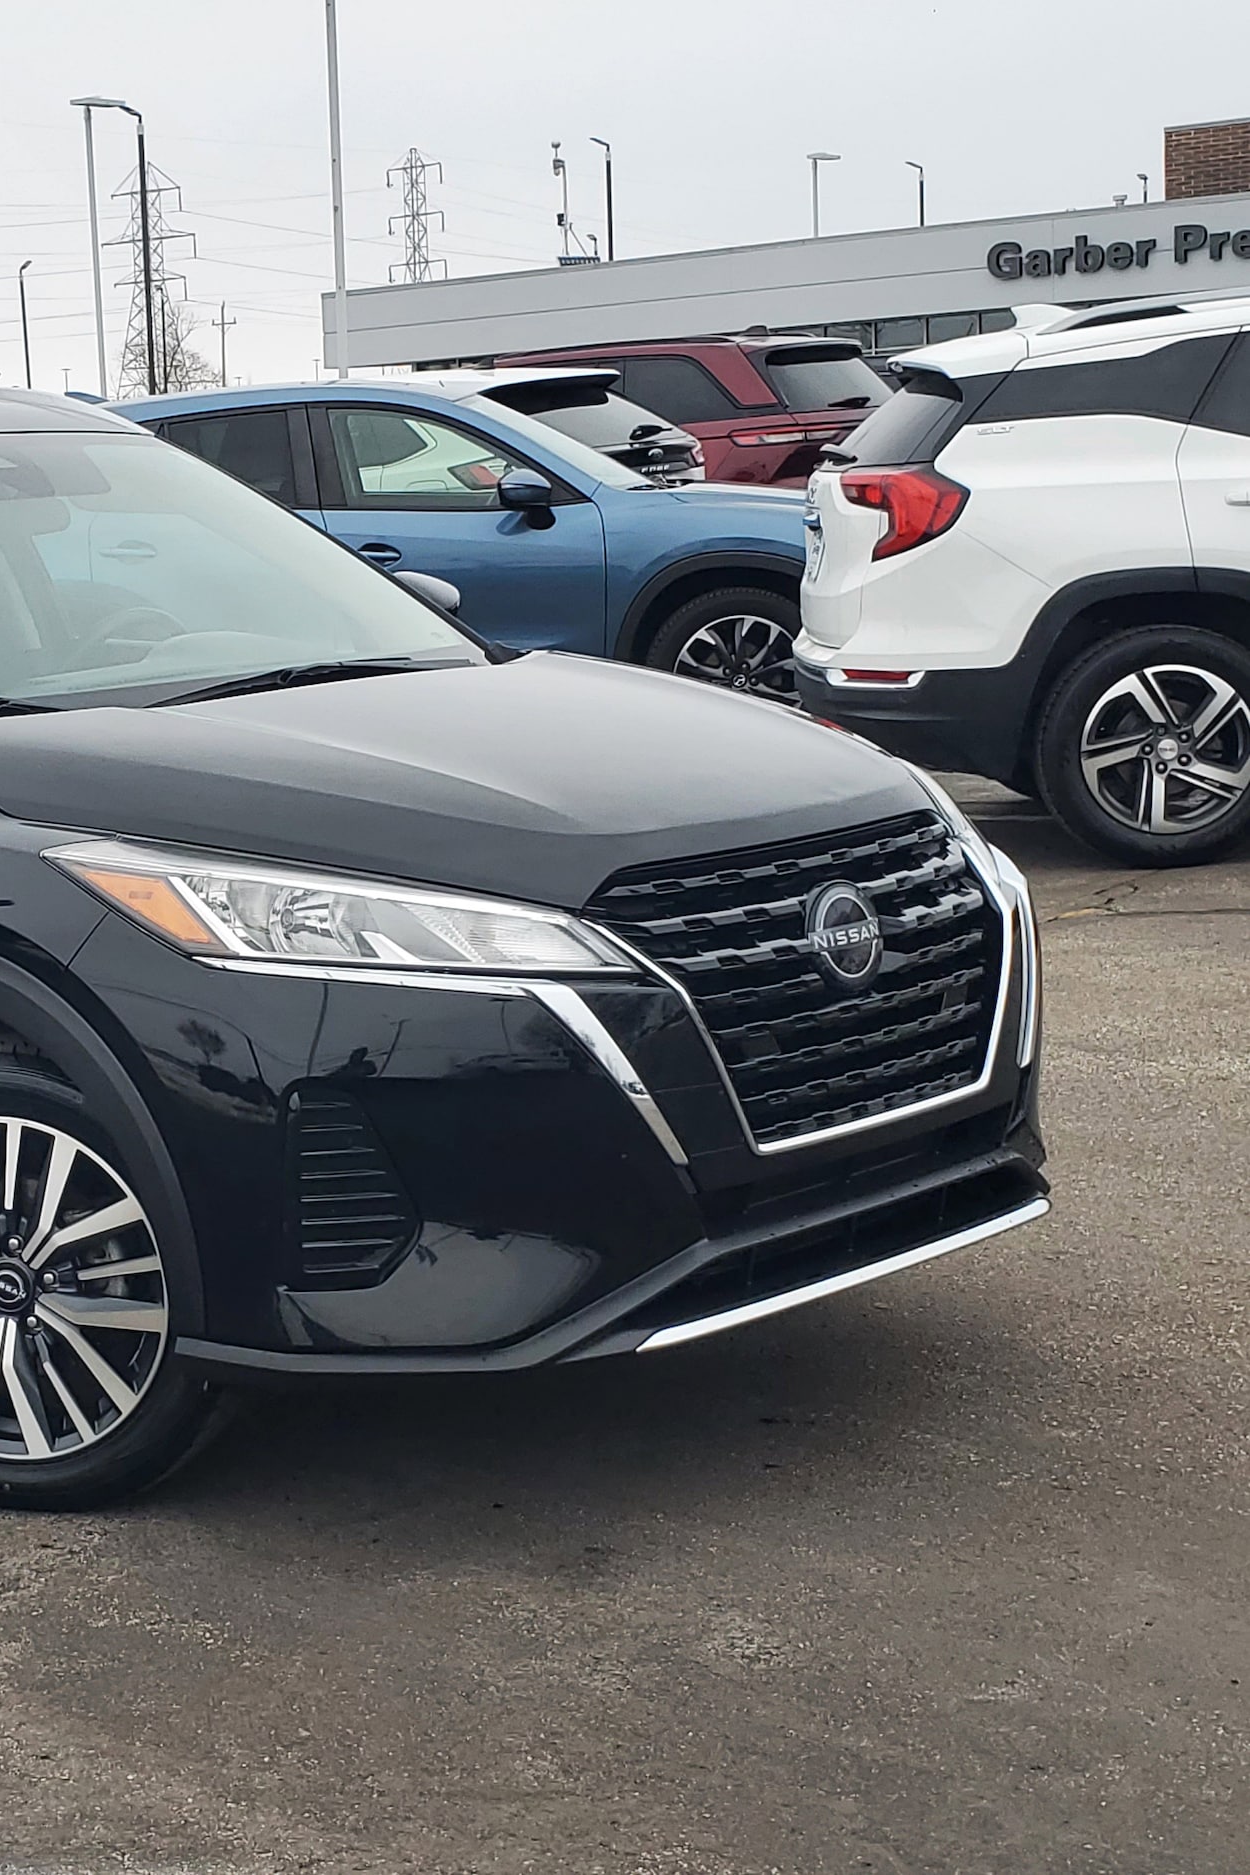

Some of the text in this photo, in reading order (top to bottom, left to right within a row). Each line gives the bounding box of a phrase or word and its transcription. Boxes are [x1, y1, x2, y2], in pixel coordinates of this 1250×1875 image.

[987, 224, 1250, 281] Garber Pre
[812, 920, 880, 950] NISSAN
